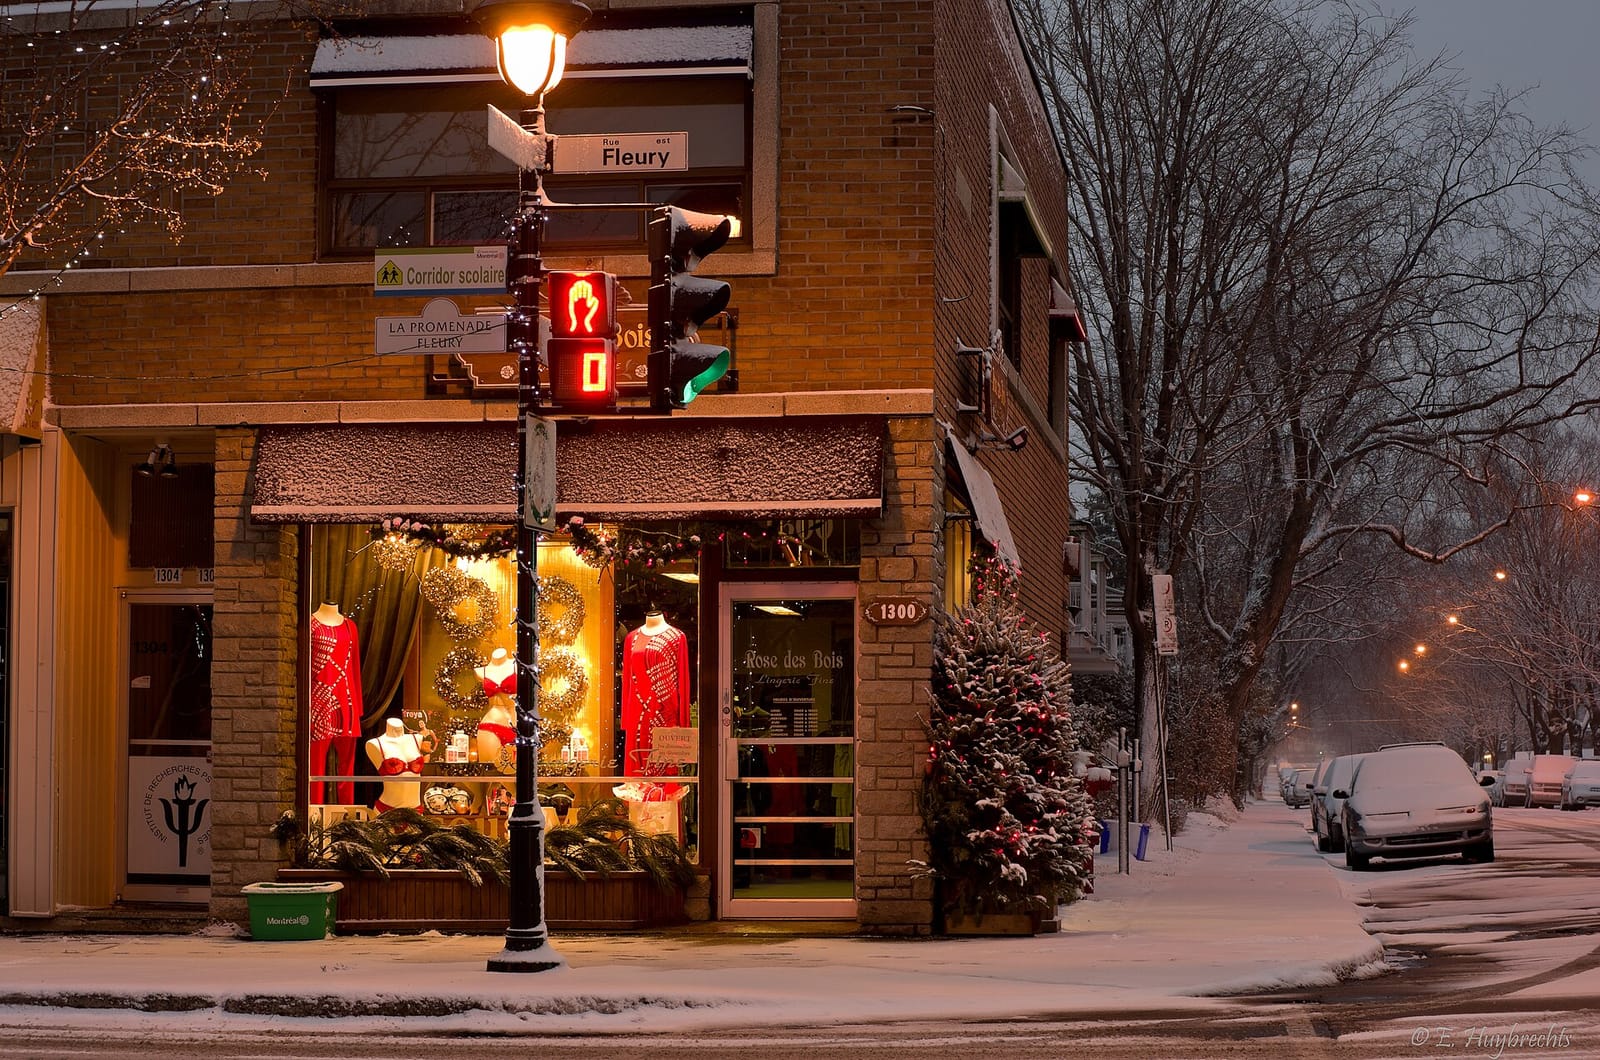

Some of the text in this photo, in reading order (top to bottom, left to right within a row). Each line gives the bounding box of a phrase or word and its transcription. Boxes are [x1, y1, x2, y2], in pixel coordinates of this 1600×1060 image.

[602, 137, 671, 146] Rue est
[602, 147, 670, 169] Fleury
[407, 265, 505, 285] Corridor scolaire
[389, 320, 492, 334] LA PROMENADE
[417, 336, 464, 349] FLEURY
[156, 569, 215, 582] 1304 130
[880, 603, 916, 620] 1300
[745, 649, 844, 669] Rose des Bois
[806, 672, 835, 686] Fine
[143, 764, 201, 844] INSTITUT DE RECHERCHES
[266, 916, 299, 926] Montréal
